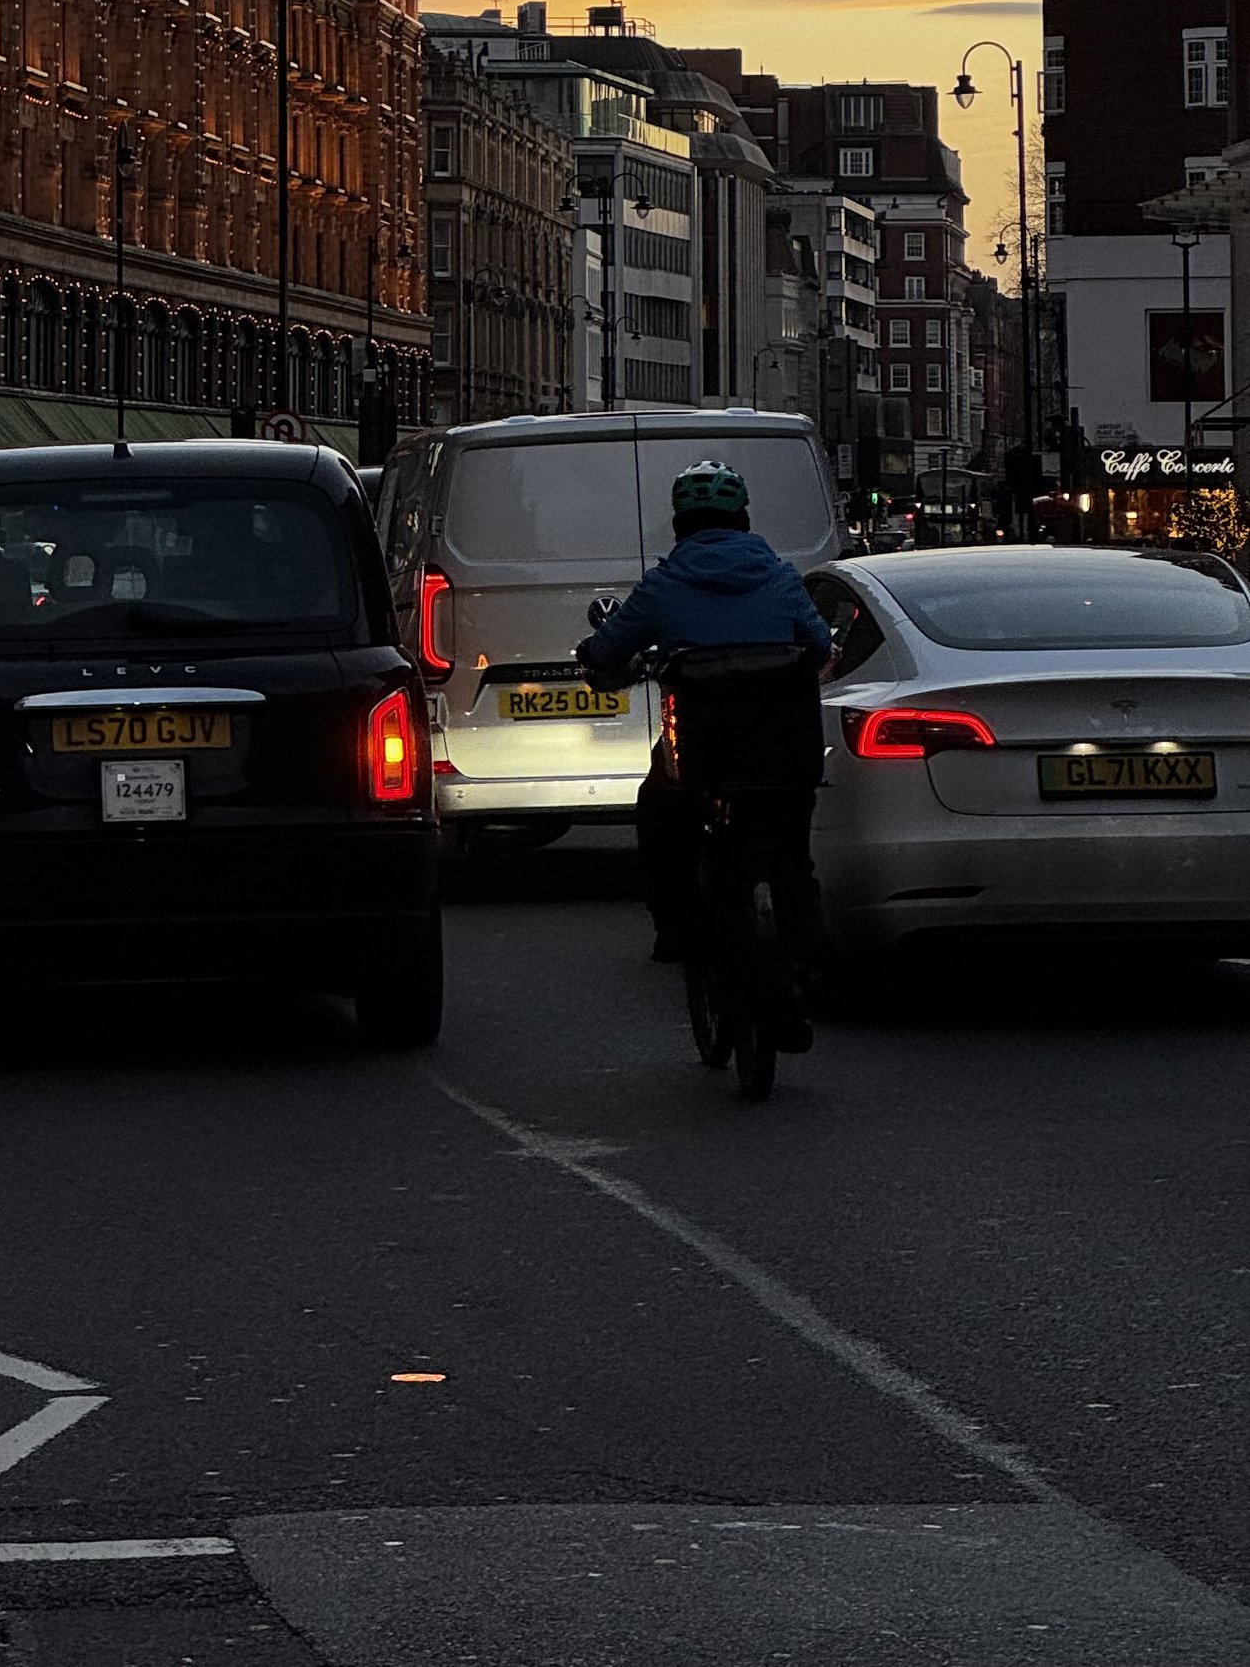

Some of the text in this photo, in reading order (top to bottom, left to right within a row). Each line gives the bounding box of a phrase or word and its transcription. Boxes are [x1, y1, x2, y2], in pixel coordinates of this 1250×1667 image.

[1100, 449, 1235, 482] Caffé Cocerto
[81, 665, 198, 677] LEVC
[508, 691, 569, 713] RK25
[65, 715, 216, 746] LS70 GJV
[1066, 757, 1203, 786] GL71 KXX
[116, 782, 175, 798] 124479
